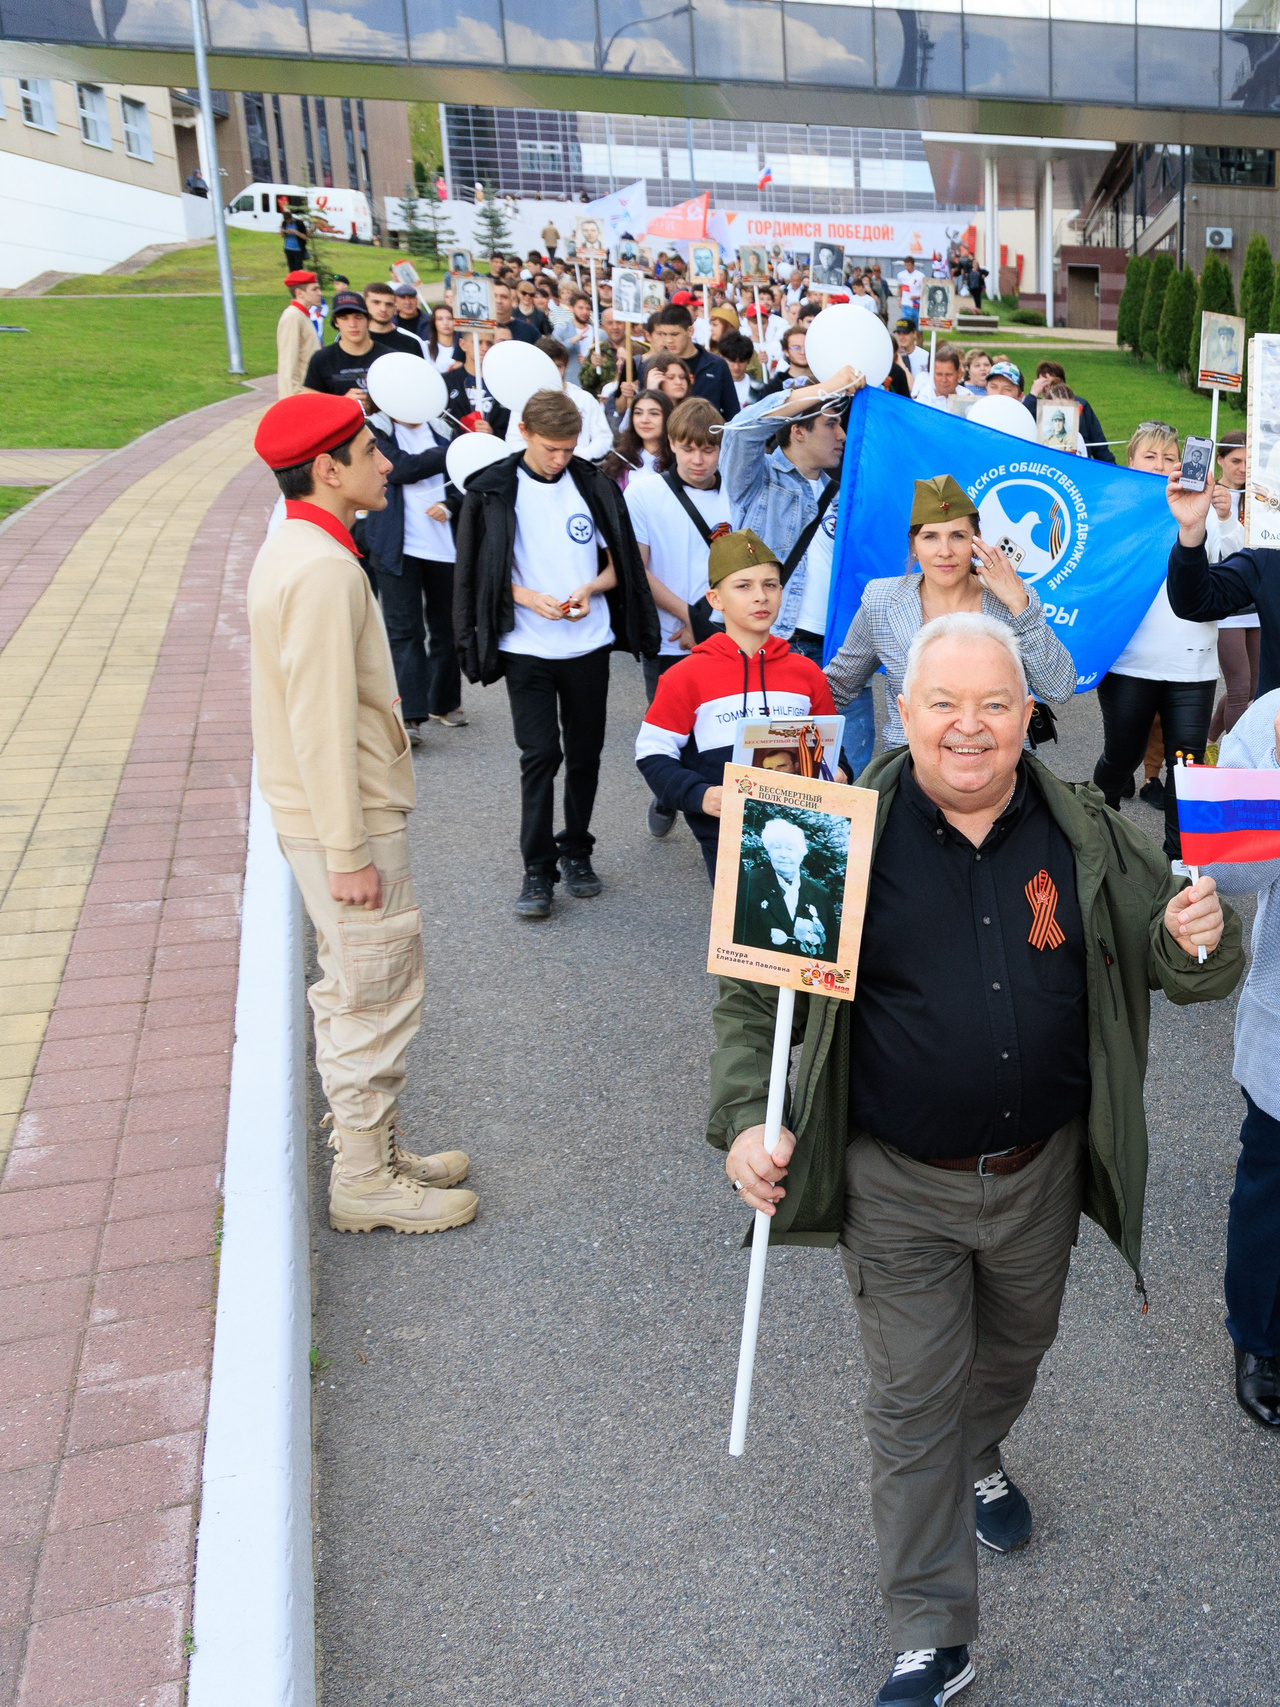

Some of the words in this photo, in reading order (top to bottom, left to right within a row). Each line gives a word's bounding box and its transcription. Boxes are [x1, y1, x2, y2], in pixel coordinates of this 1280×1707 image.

[747, 220, 822, 237] ГОРДИМСЯ
[828, 223, 895, 242] ПОБЕДОЙ!
[967, 464, 1007, 502] ЙСКОЕ
[1009, 462, 1088, 521] ОБЩЕСТВЕННОЕ
[1046, 522, 1089, 591] ДВИЖЕНИЕ
[716, 707, 755, 724] TOMMY
[758, 792, 783, 803] ПОЛК
[783, 796, 818, 809] РОССИИ
[759, 785, 822, 803] БЕССМЕРТНЫЙ
[716, 947, 749, 959] Степура
[716, 954, 754, 966] Елизавета
[755, 961, 791, 973] Павловна
[824, 972, 835, 991] 9
